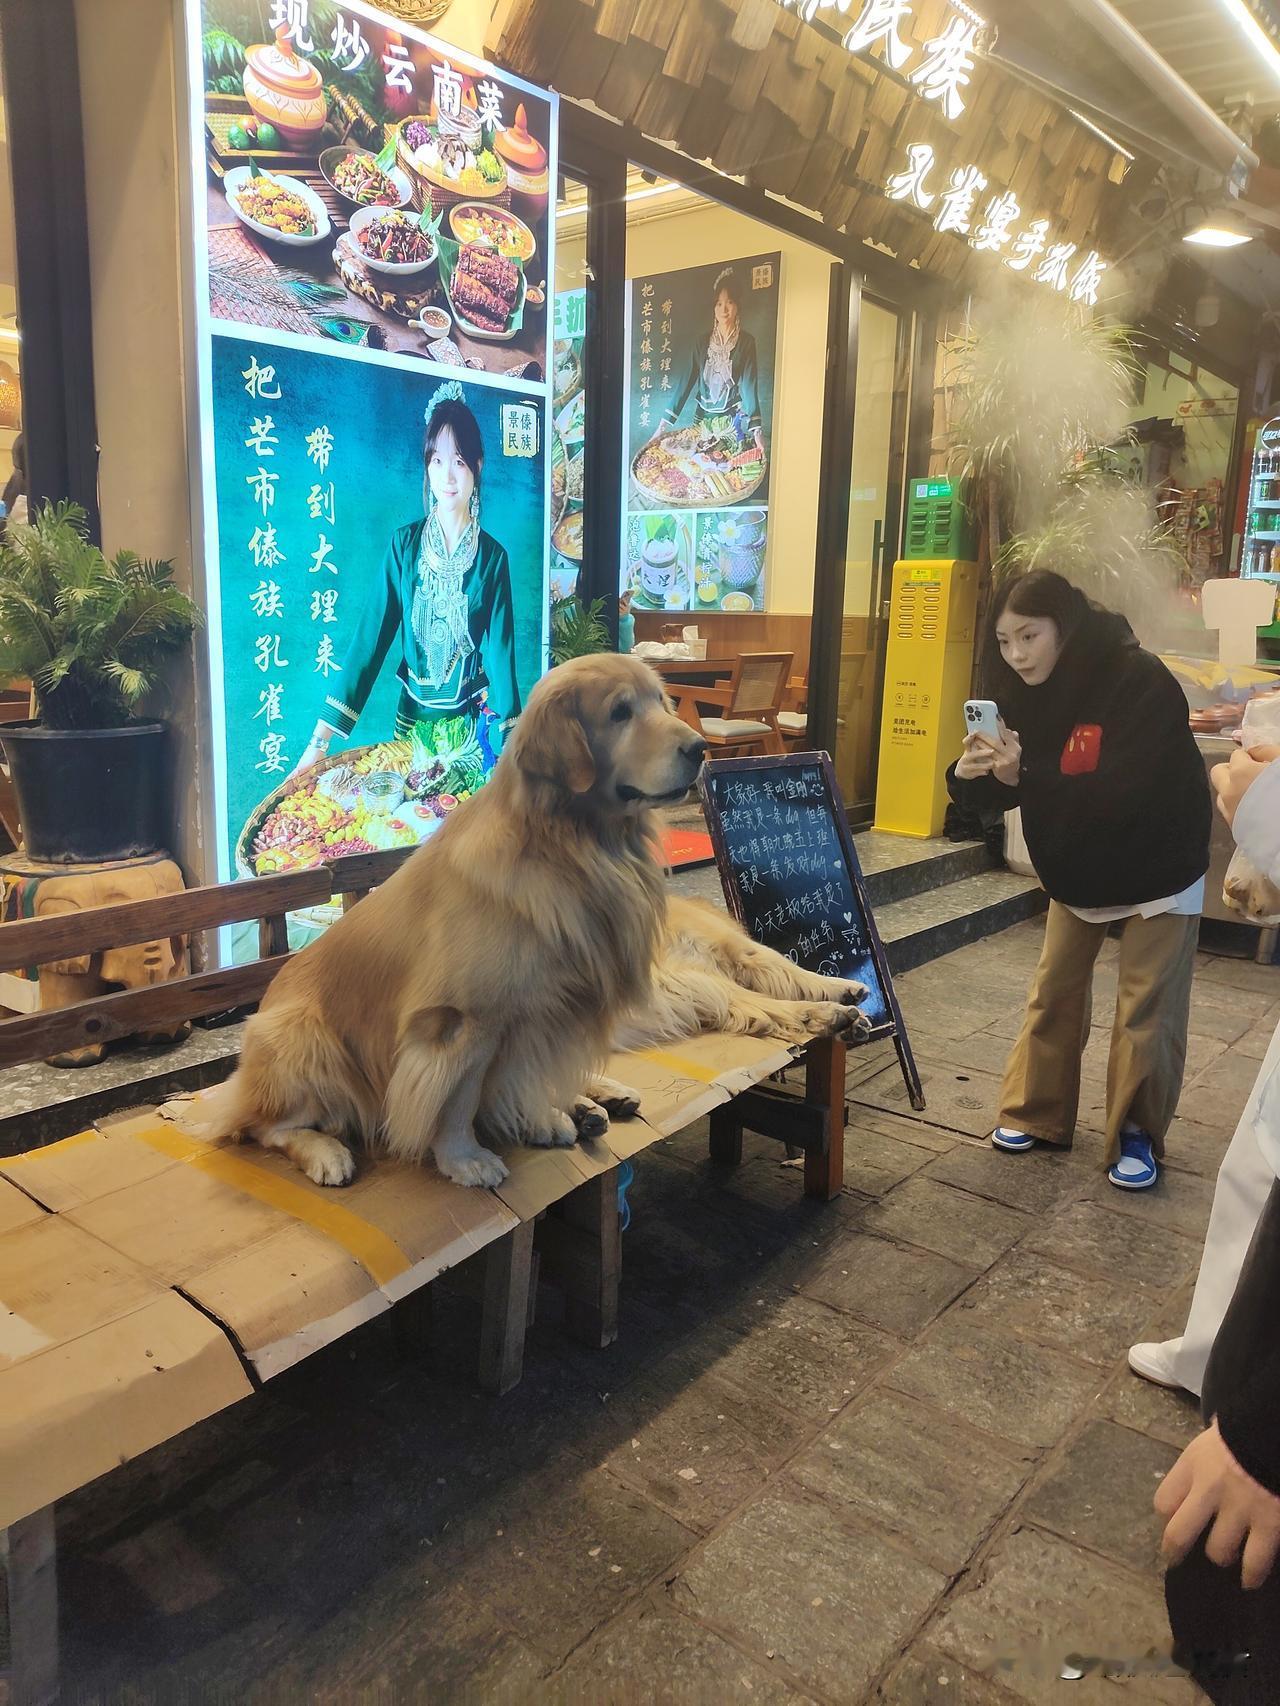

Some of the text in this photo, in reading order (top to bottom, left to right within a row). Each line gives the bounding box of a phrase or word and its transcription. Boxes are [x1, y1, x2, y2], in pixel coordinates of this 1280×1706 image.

[268, 0, 506, 133] 现炒云南菜
[775, 0, 978, 120] 民族
[639, 282, 655, 428] 把芒市傣族孔雀宴
[659, 299, 673, 392] 带到大理来
[241, 354, 289, 775] 把芒市傣族孔雀宴
[304, 426, 343, 679] 带到大理来
